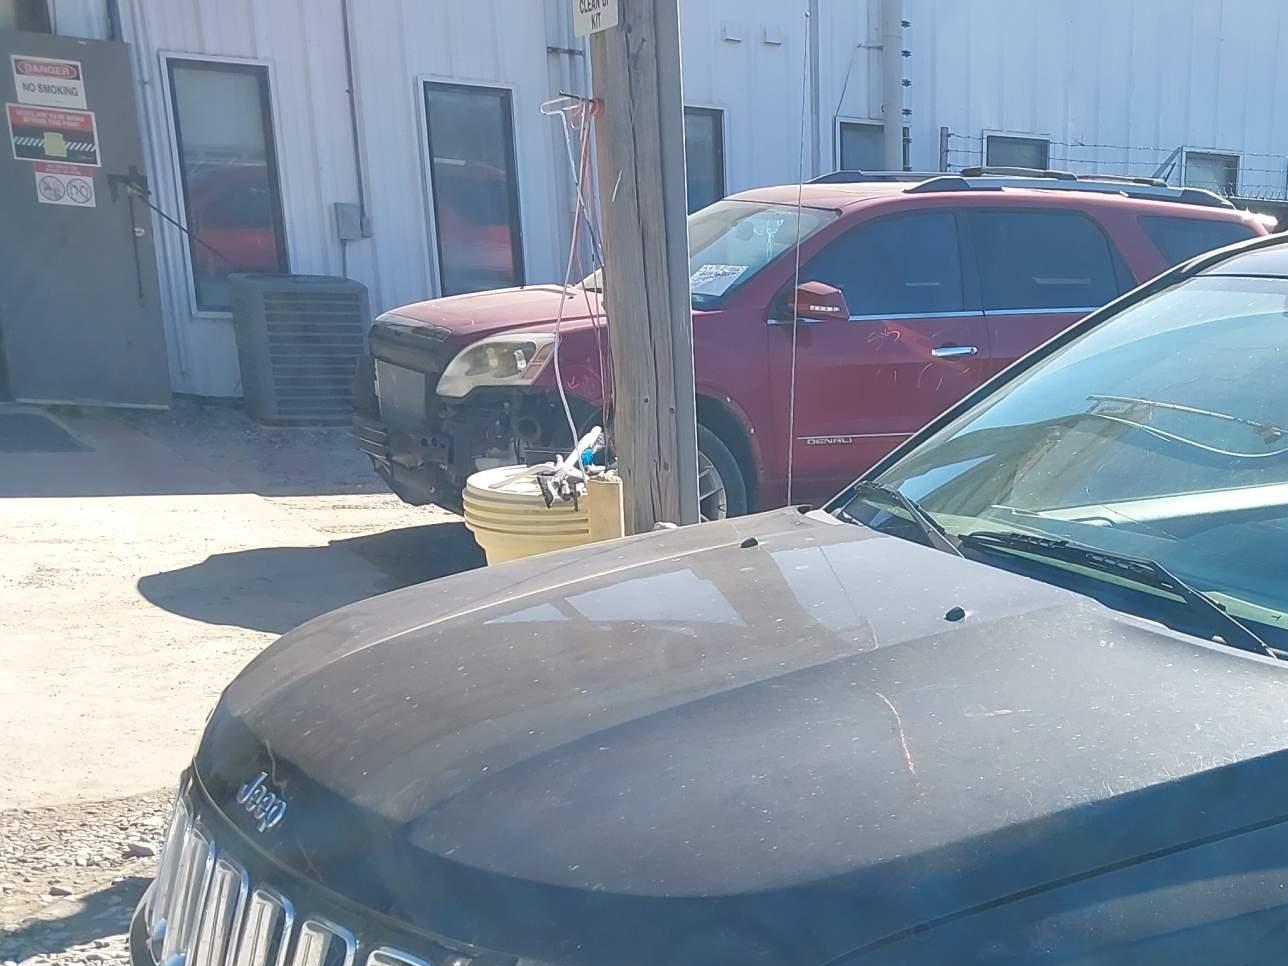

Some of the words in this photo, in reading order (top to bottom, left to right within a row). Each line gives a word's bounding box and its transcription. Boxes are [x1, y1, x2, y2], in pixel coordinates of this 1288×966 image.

[591, 12, 601, 30] KIT
[24, 63, 70, 77] DANGER
[22, 82, 36, 93] NO
[38, 83, 79, 97] SMOKING
[807, 437, 852, 445] DENALI
[237, 772, 287, 832] Jeep
